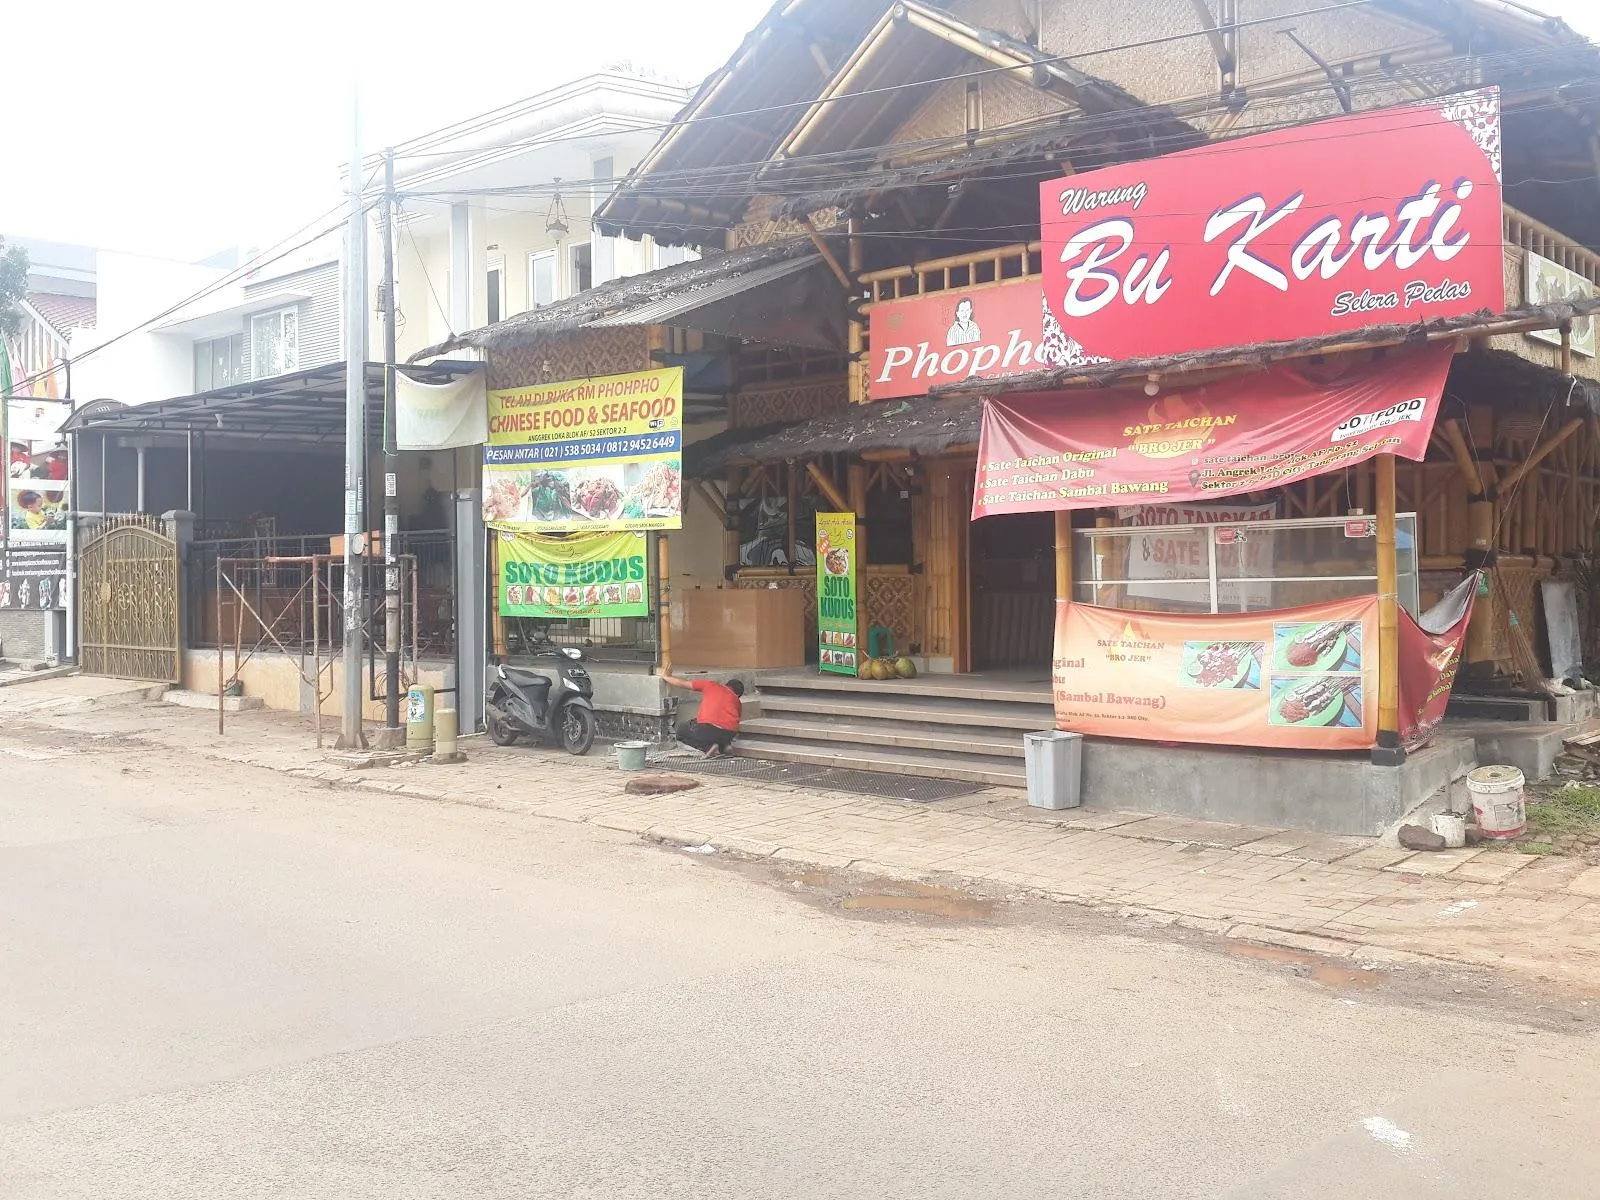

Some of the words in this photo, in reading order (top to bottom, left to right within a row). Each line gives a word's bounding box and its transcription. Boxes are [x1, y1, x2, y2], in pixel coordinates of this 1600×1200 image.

[1059, 178, 1148, 216] Warung
[1059, 215, 1173, 318] Bu
[1203, 176, 1476, 297] Karti
[1330, 290, 1400, 317] Selera
[1404, 279, 1472, 308] Pedas
[577, 385, 596, 400] RM
[598, 376, 660, 398] PHOHPHO
[489, 411, 541, 434] CHINESE
[543, 407, 585, 429] FOOD
[587, 407, 600, 425] &
[601, 397, 676, 424] SEAFOOD
[1375, 400, 1421, 421] FOOD
[1122, 422, 1163, 437] SATE
[1164, 414, 1237, 431] TAICHAN
[486, 447, 514, 461] PESAN
[564, 444, 580, 457] 538
[580, 442, 601, 455] 5034
[607, 440, 628, 453] 0812
[630, 438, 653, 450] 9452
[653, 436, 676, 449] 6449
[987, 459, 1011, 472] Sate
[1013, 455, 1061, 469] Taichan
[1062, 446, 1118, 464] Original
[985, 477, 1009, 489] Sate
[1011, 472, 1059, 487] Taichan
[1061, 468, 1096, 481] Dabu
[1217, 467, 1258, 478] Angrek
[983, 493, 1007, 505] Sate
[1008, 489, 1057, 504] Taichan
[1058, 484, 1108, 499] Sambal
[1110, 481, 1169, 495] Bawang
[1201, 480, 1238, 490] Sektor
[1152, 538, 1201, 566] SATE
[505, 560, 559, 585] SOTO
[563, 555, 645, 585] KUDUS
[823, 575, 850, 598] SOTO
[820, 597, 854, 620] KUDUS
[1096, 639, 1119, 648] SATE
[1120, 640, 1166, 650] TAICHAN
[1056, 689, 1104, 704] (Sambal
[1105, 691, 1167, 710] Bawang)
